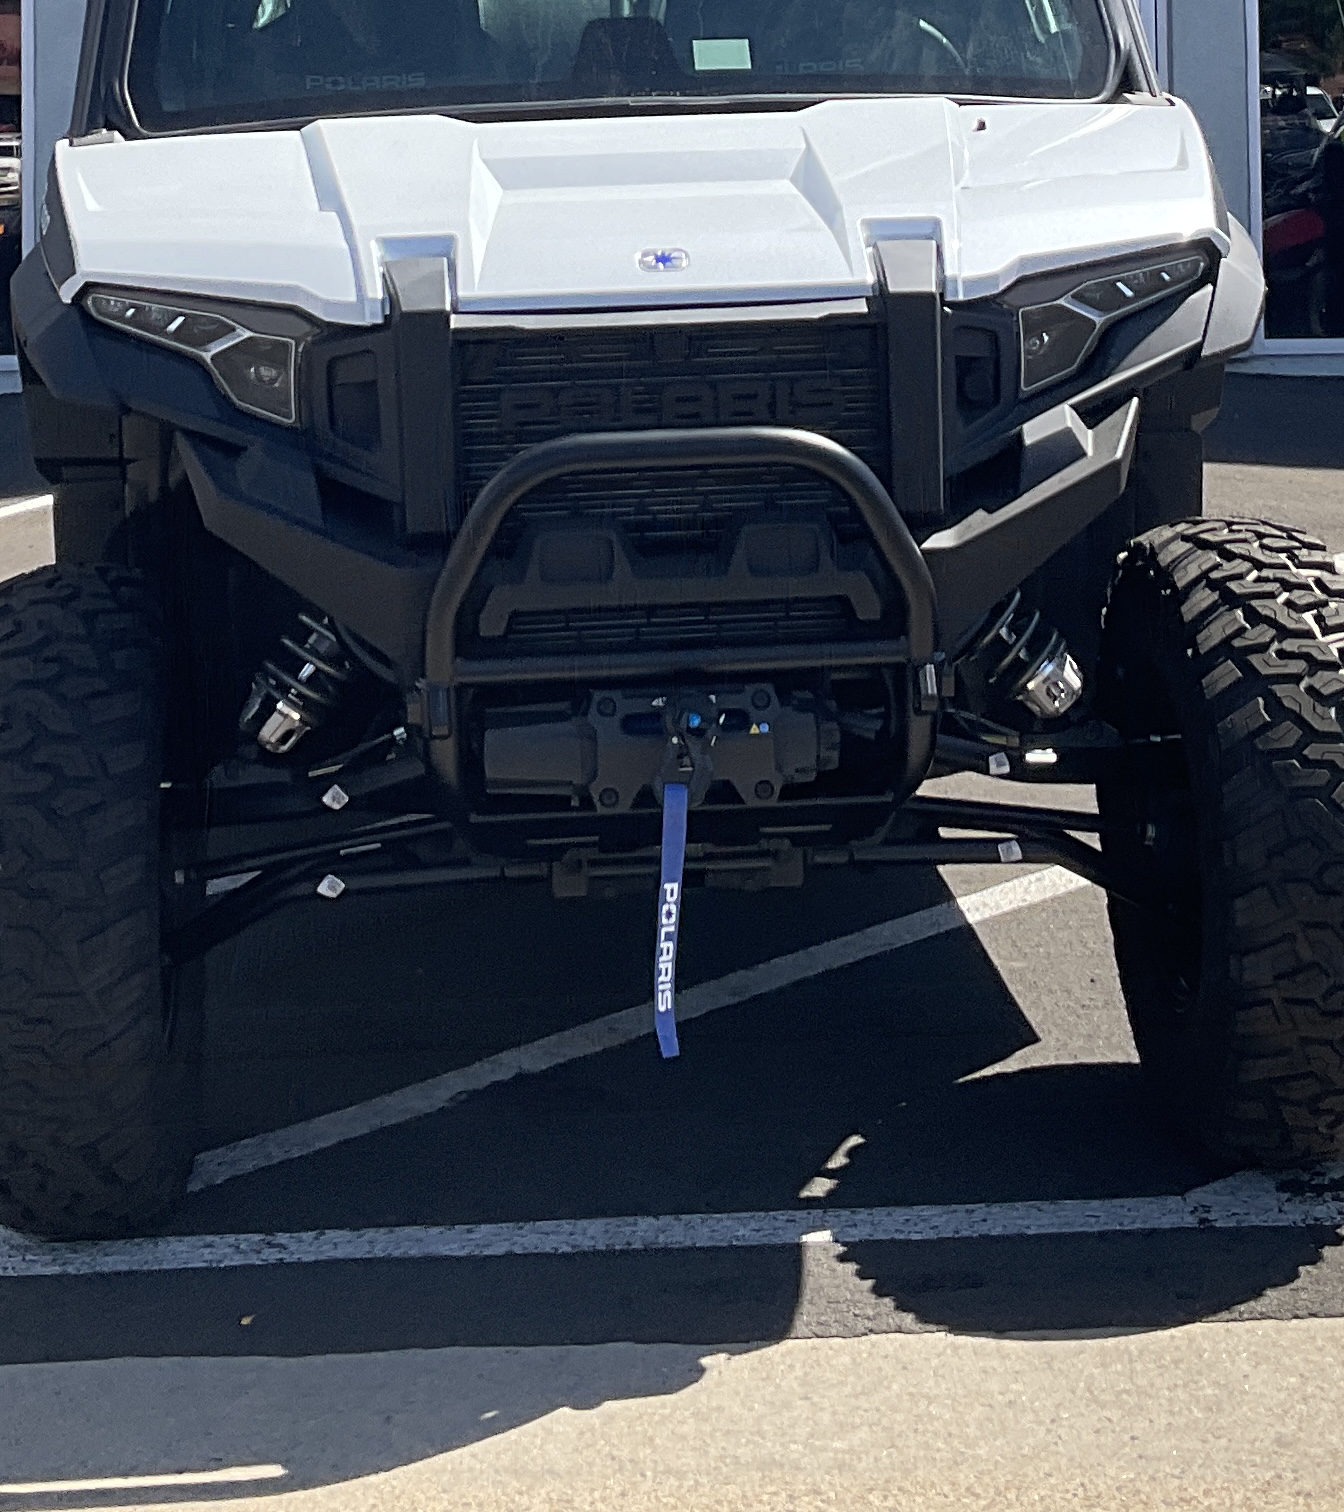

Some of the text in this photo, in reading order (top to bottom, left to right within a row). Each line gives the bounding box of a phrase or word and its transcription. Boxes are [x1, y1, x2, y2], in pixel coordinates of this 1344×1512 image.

[306, 72, 426, 91] POLARIS
[502, 380, 846, 429] POLARIS
[657, 882, 678, 1012] POLARIS
